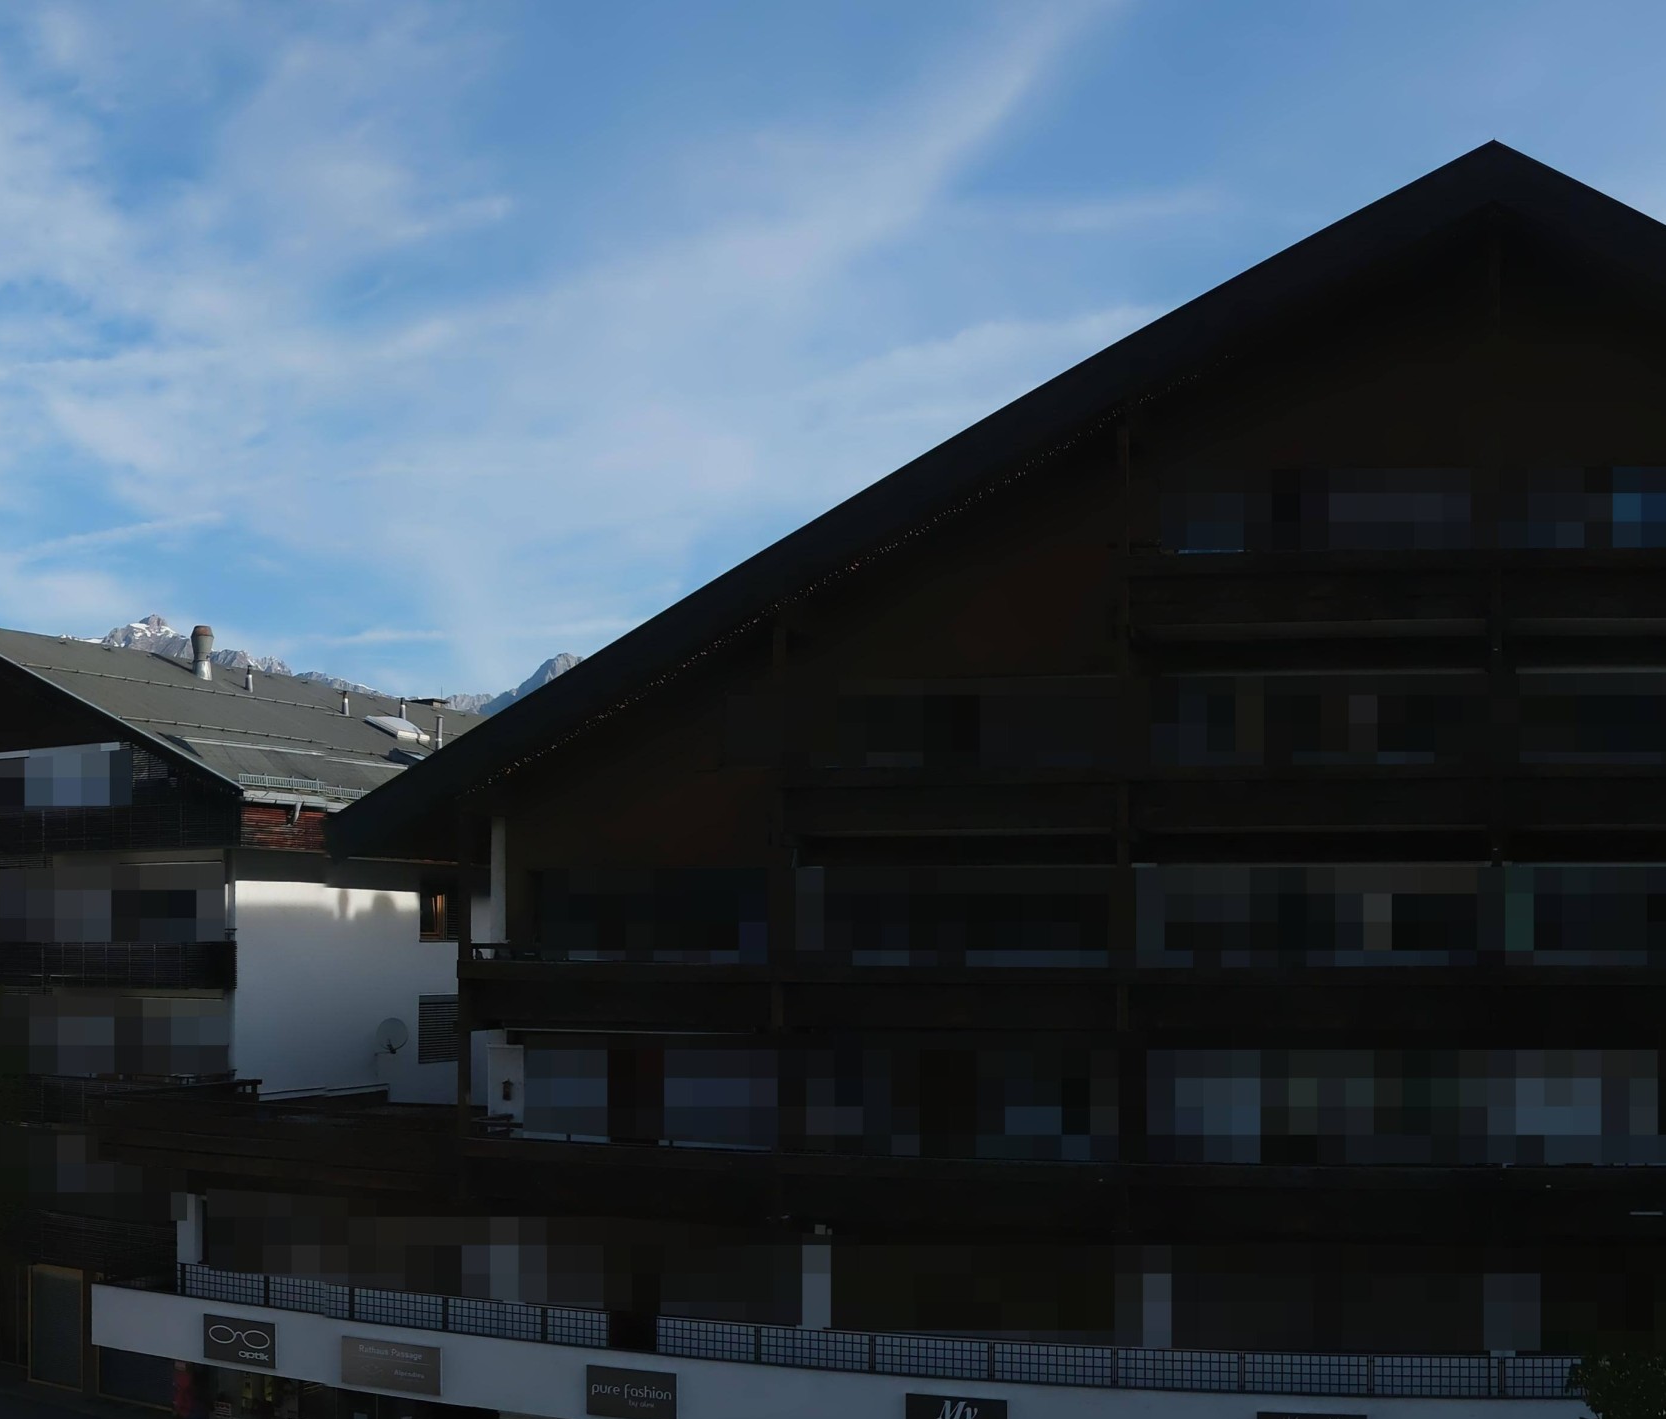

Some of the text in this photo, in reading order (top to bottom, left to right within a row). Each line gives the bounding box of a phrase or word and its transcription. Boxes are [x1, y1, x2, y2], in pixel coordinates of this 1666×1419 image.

[238, 1350, 269, 1361] optik
[358, 1344, 422, 1361] Rathaus Passage
[591, 1383, 672, 1401] pure fashion
